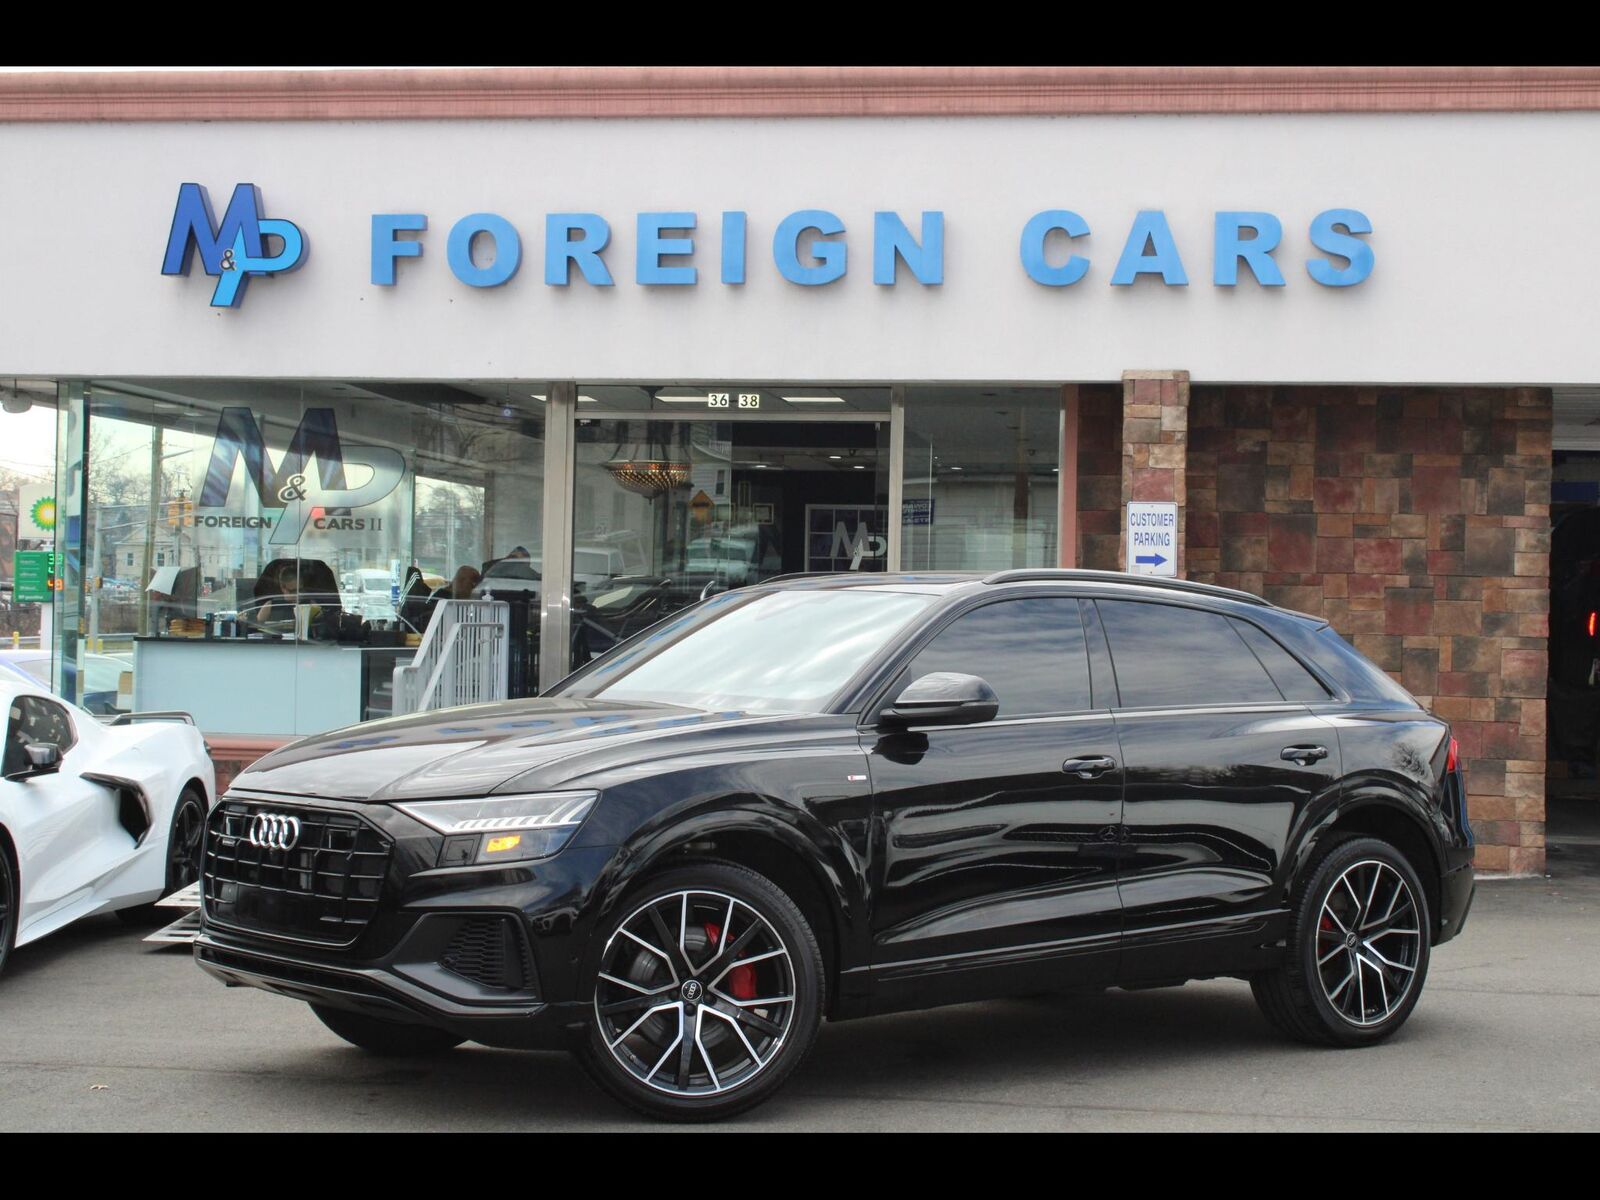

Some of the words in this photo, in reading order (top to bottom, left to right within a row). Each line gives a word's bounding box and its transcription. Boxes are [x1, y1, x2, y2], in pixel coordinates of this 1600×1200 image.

[371, 211, 946, 288] FOREIGN
[1020, 208, 1376, 288] CARS
[710, 395, 728, 406] 36
[740, 395, 758, 407] 38
[194, 515, 272, 529] FOREIGN
[313, 518, 365, 531] CARS
[1130, 513, 1174, 527] CUSTOMER
[1134, 532, 1170, 546] PARKING
